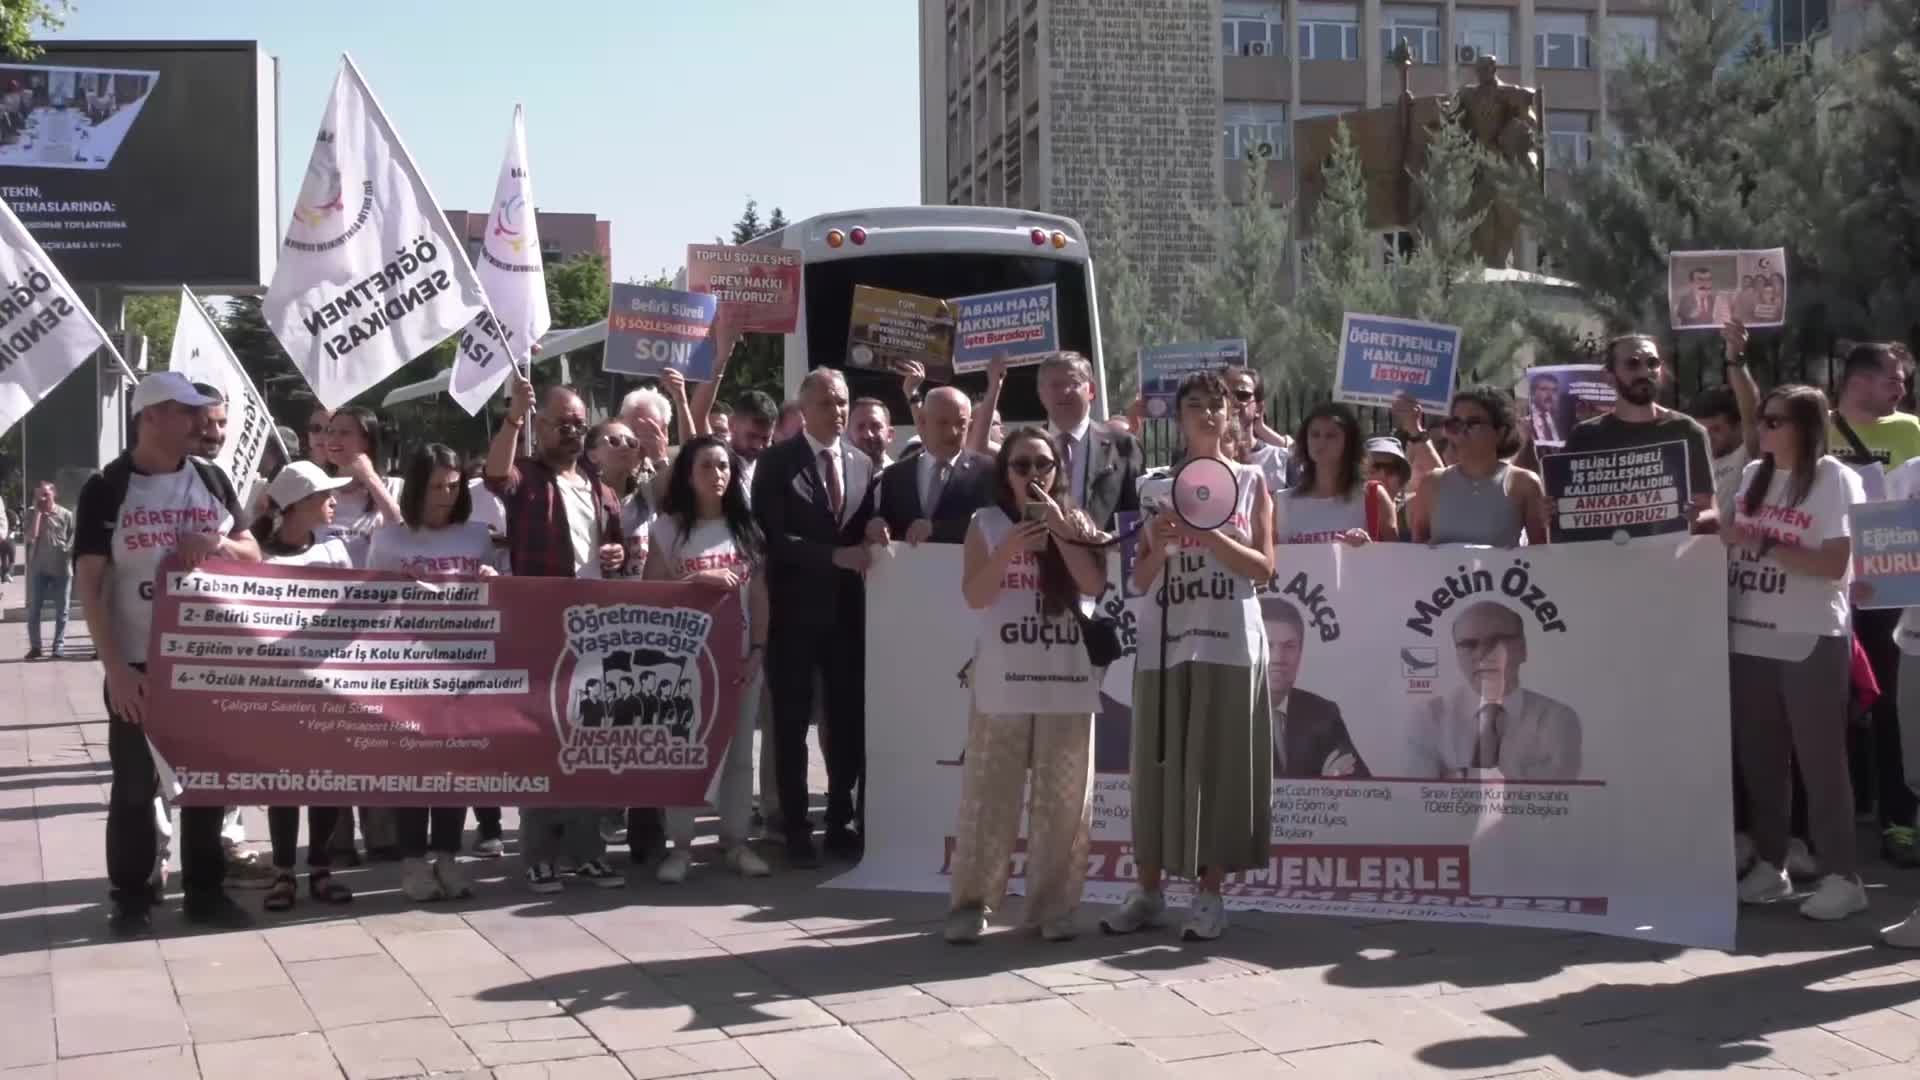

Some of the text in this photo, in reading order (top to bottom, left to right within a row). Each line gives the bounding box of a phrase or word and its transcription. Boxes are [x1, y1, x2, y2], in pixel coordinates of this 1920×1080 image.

[13, 201, 117, 212] TEMASLARINDA:
[696, 250, 733, 261] TOPLU
[710, 275, 783, 289] GREV HAKKI
[960, 301, 1003, 318] ABAN
[635, 338, 691, 365] SON!
[1350, 326, 1453, 354] ÖĞRETMENLER
[1363, 347, 1438, 368] HAKLARINI
[1570, 448, 1662, 471] BELİRLİ SÜRELİ
[1587, 460, 1664, 482] SÖZLEŞMESİ
[1564, 475, 1673, 497] KALDIRILMALIDIR!
[122, 506, 218, 529] ÖĞRETMEN
[1728, 561, 1786, 595] ÜÇLÜ!
[175, 577, 479, 603] 1- Taban Maaş Hemen Yasaya Girmelidir!
[1406, 558, 1567, 637] Metin Özer
[1282, 571, 1341, 642] Akça
[183, 608, 495, 630] 2- Belirli Süreli İş Sözleşmesi Kaldırılmalıdır!
[567, 607, 709, 638] Öğretmenliği
[187, 641, 233, 657] Eğitim
[236, 646, 253, 656] ve
[257, 643, 296, 657] Güzel
[301, 645, 352, 659] Sanatlar
[355, 644, 367, 662] İş
[370, 648, 400, 660] Kolu
[403, 647, 487, 660] Kurulmalıdır!
[570, 629, 698, 655] Yaşatacağız
[333, 677, 368, 689] Kamu
[371, 677, 387, 690] ile
[390, 678, 429, 692] Eşitlik
[432, 677, 523, 692] Sağlanmalıdır!
[562, 740, 704, 771] ÇALIŞACAĞIZ
[176, 766, 550, 792] ÖZEL SEKTÖR ÖĞRETMENLERİ SENDİKASI
